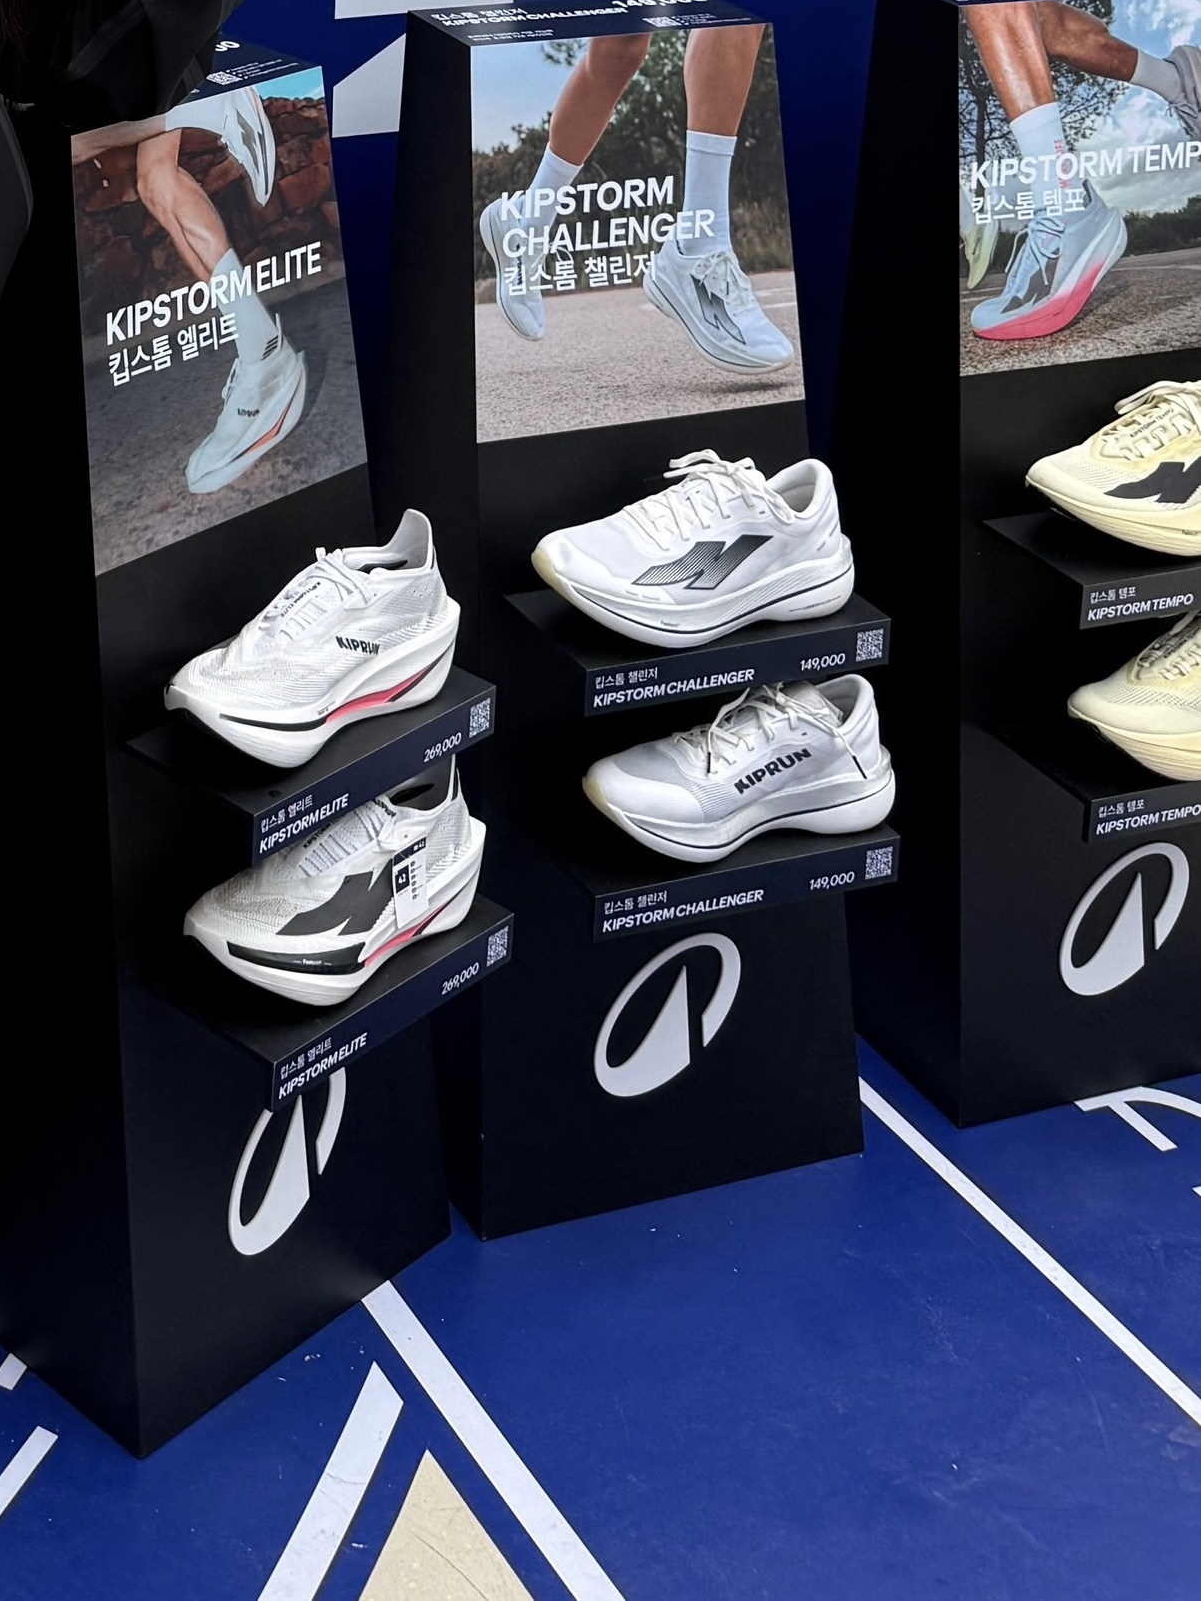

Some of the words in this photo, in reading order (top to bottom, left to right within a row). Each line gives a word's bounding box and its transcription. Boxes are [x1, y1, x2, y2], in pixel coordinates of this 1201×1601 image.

[971, 148, 1123, 189] KIPSTORM
[501, 175, 674, 221] KIPSTORM
[972, 192, 1036, 224] 킵스톰
[1043, 188, 1085, 217] 템포
[502, 209, 715, 258] CHALLENGER
[106, 265, 252, 345] KIPSTORM
[256, 241, 322, 293] ELITE
[504, 261, 577, 296] 킵스톰
[584, 251, 655, 288] 챌린저
[109, 334, 173, 386] 킵스톰
[177, 313, 239, 361] 엘리트
[1087, 600, 1151, 621] KIPSTORM
[1152, 593, 1194, 610] TEMPO
[799, 652, 846, 671] 149,000
[593, 684, 666, 707] KIPSTORM
[667, 668, 755, 693] CHALLENGER
[423, 732, 462, 762] 269,000
[734, 748, 812, 794] KIPRUN
[259, 808, 320, 854] KIPSTORM
[319, 793, 349, 821] ELITE
[1096, 812, 1159, 835] KIPSTORM
[1160, 804, 1201, 822] TEMPO
[809, 871, 855, 891] 149,000
[602, 908, 674, 932] KIPSTORM
[675, 889, 764, 917] CHALLENGER
[441, 962, 479, 996] 269,000
[278, 1053, 339, 1100] KIPSTORM
[337, 1032, 368, 1064] ELITE
